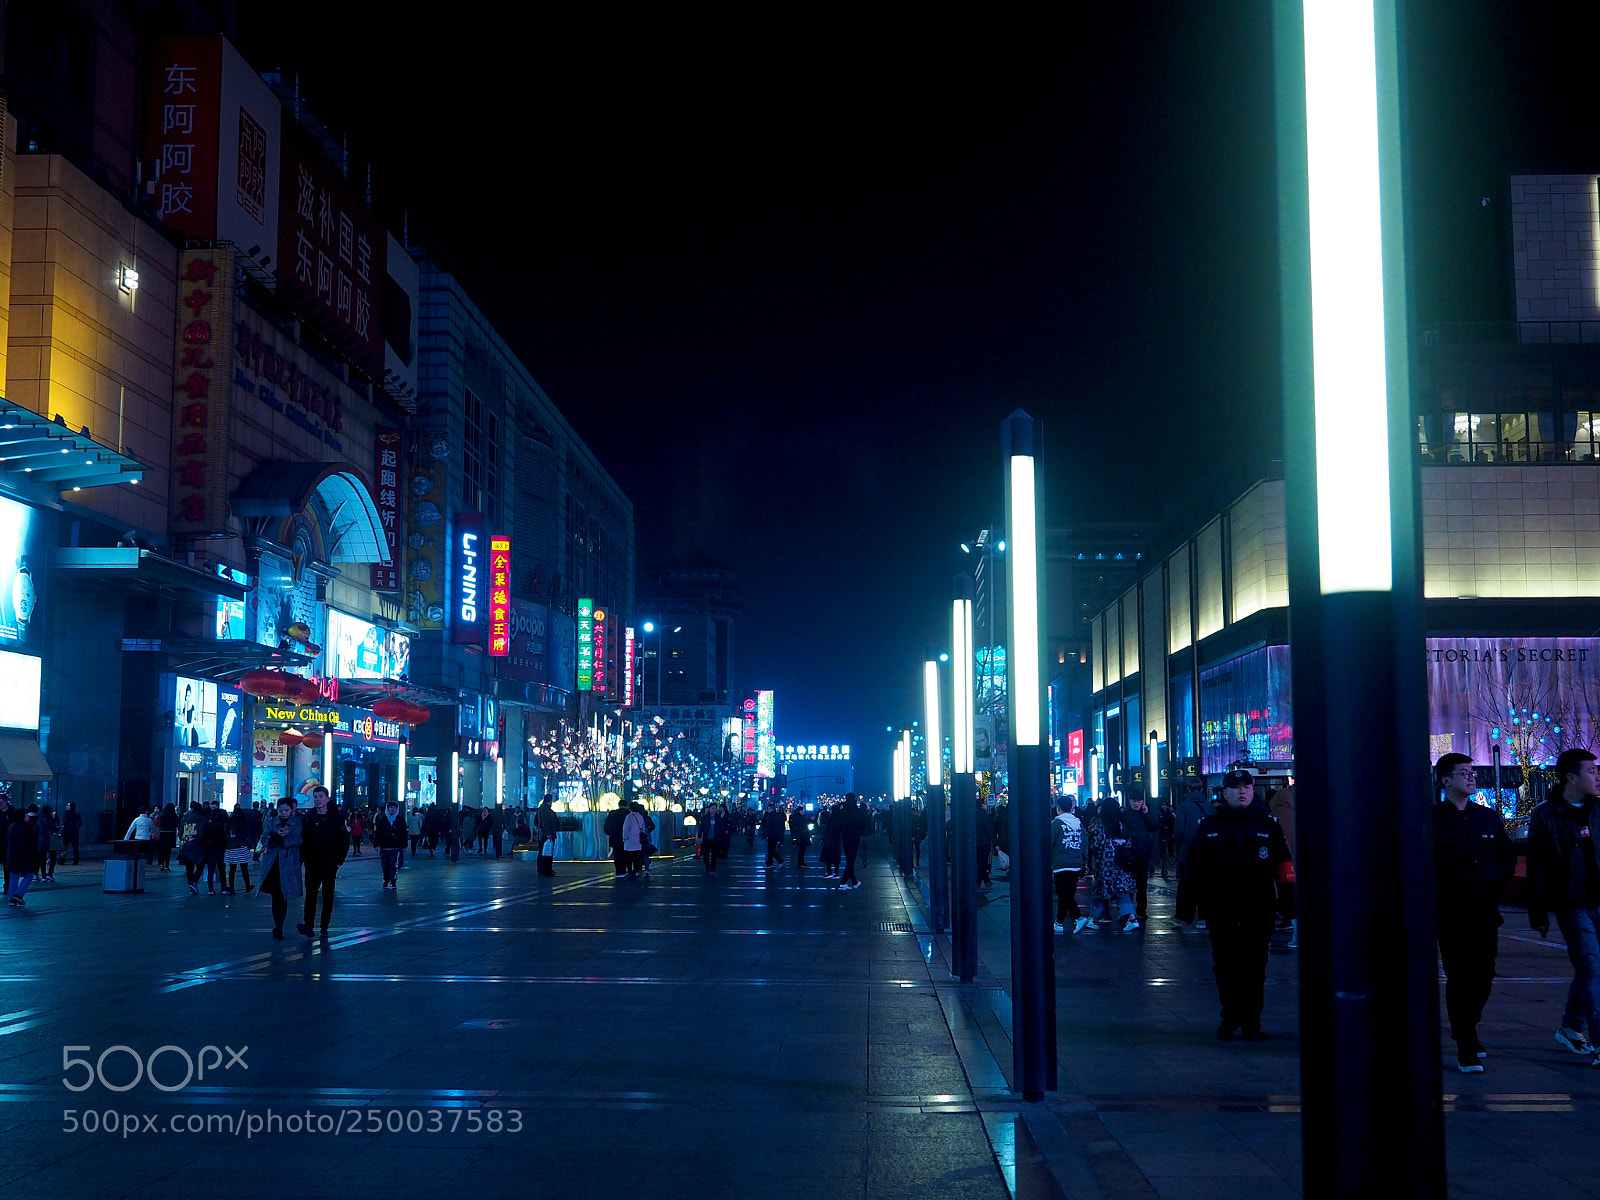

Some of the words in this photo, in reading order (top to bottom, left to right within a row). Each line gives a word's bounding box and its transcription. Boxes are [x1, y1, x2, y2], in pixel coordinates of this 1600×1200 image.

[161, 63, 197, 215] 东阿阿胶
[298, 163, 372, 285] 滋补国宝
[296, 227, 371, 342] 东阿阿胶
[462, 532, 477, 622] LI-NING
[593, 623, 605, 682] 北京同仁堂
[1517, 648, 1590, 662] SECRET
[265, 707, 297, 720] New
[299, 708, 328, 722] China
[374, 719, 400, 739] 中国工商银行
